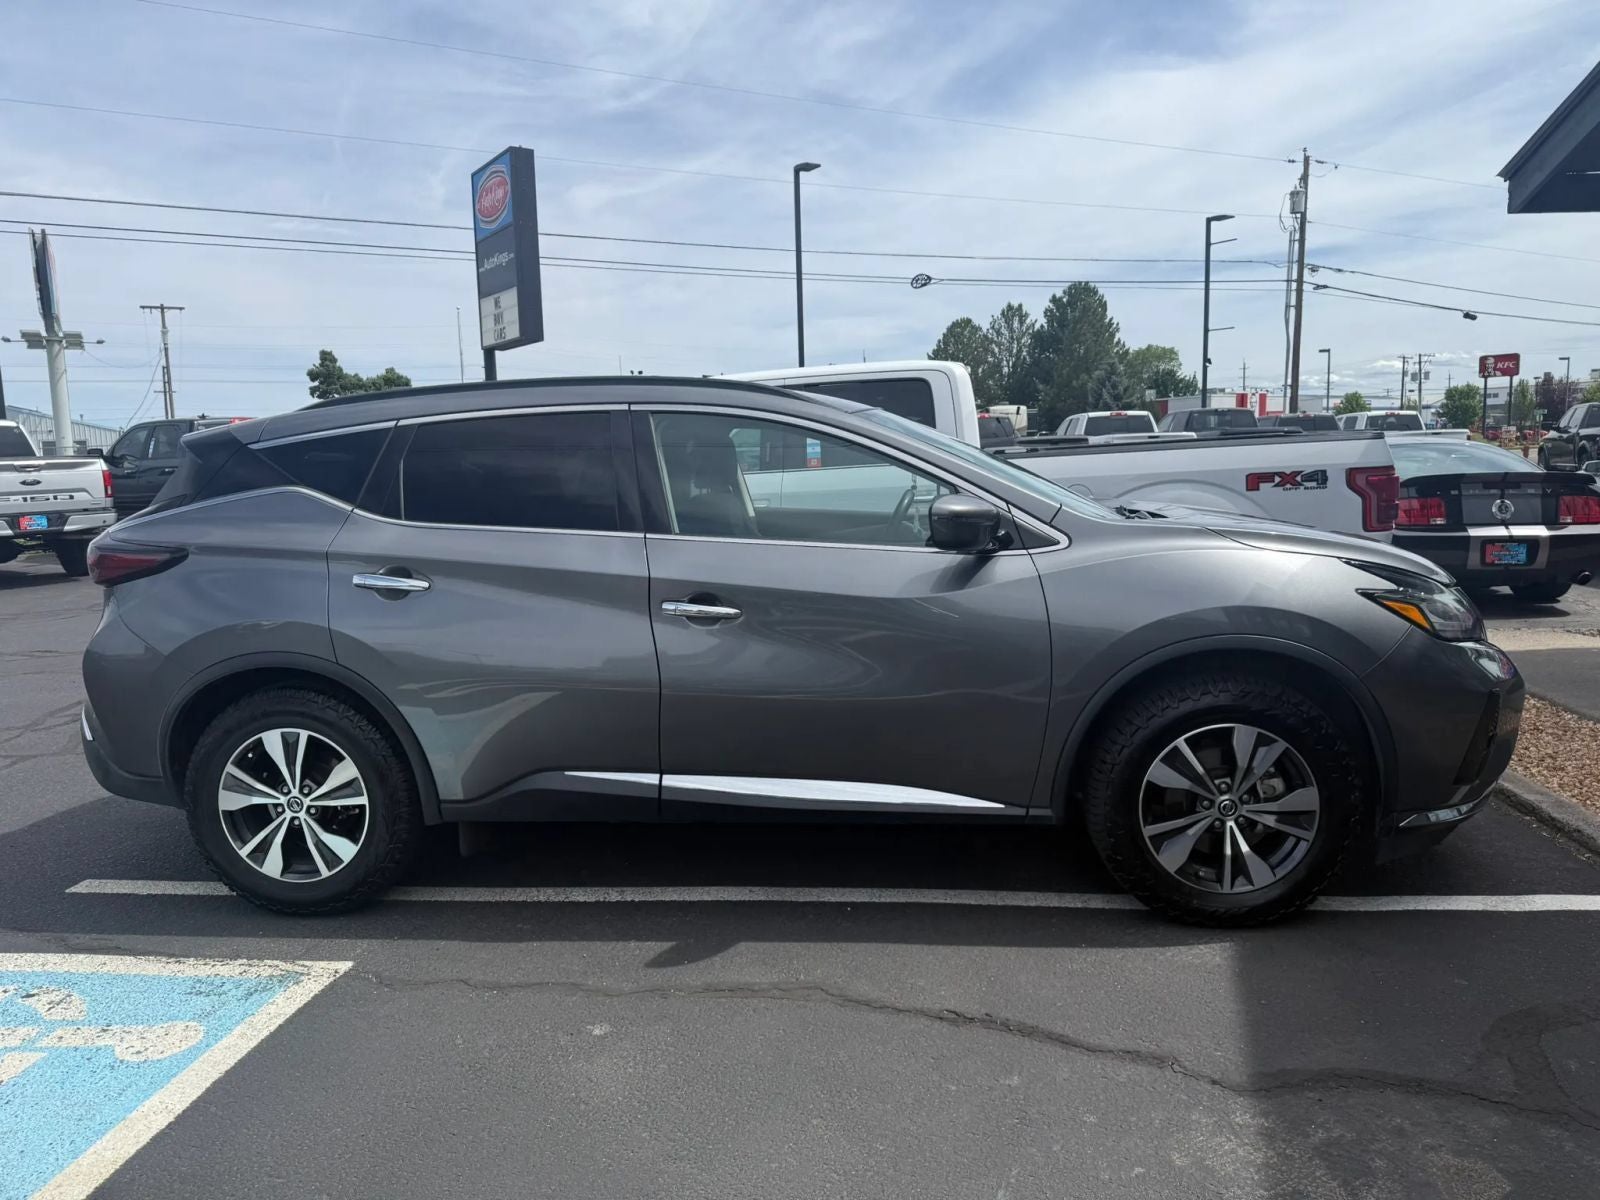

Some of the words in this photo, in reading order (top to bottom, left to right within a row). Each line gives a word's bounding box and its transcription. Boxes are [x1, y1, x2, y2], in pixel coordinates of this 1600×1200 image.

[493, 326, 506, 342] CARS
[1496, 360, 1517, 369] KFC
[1245, 469, 1329, 492] FX4
